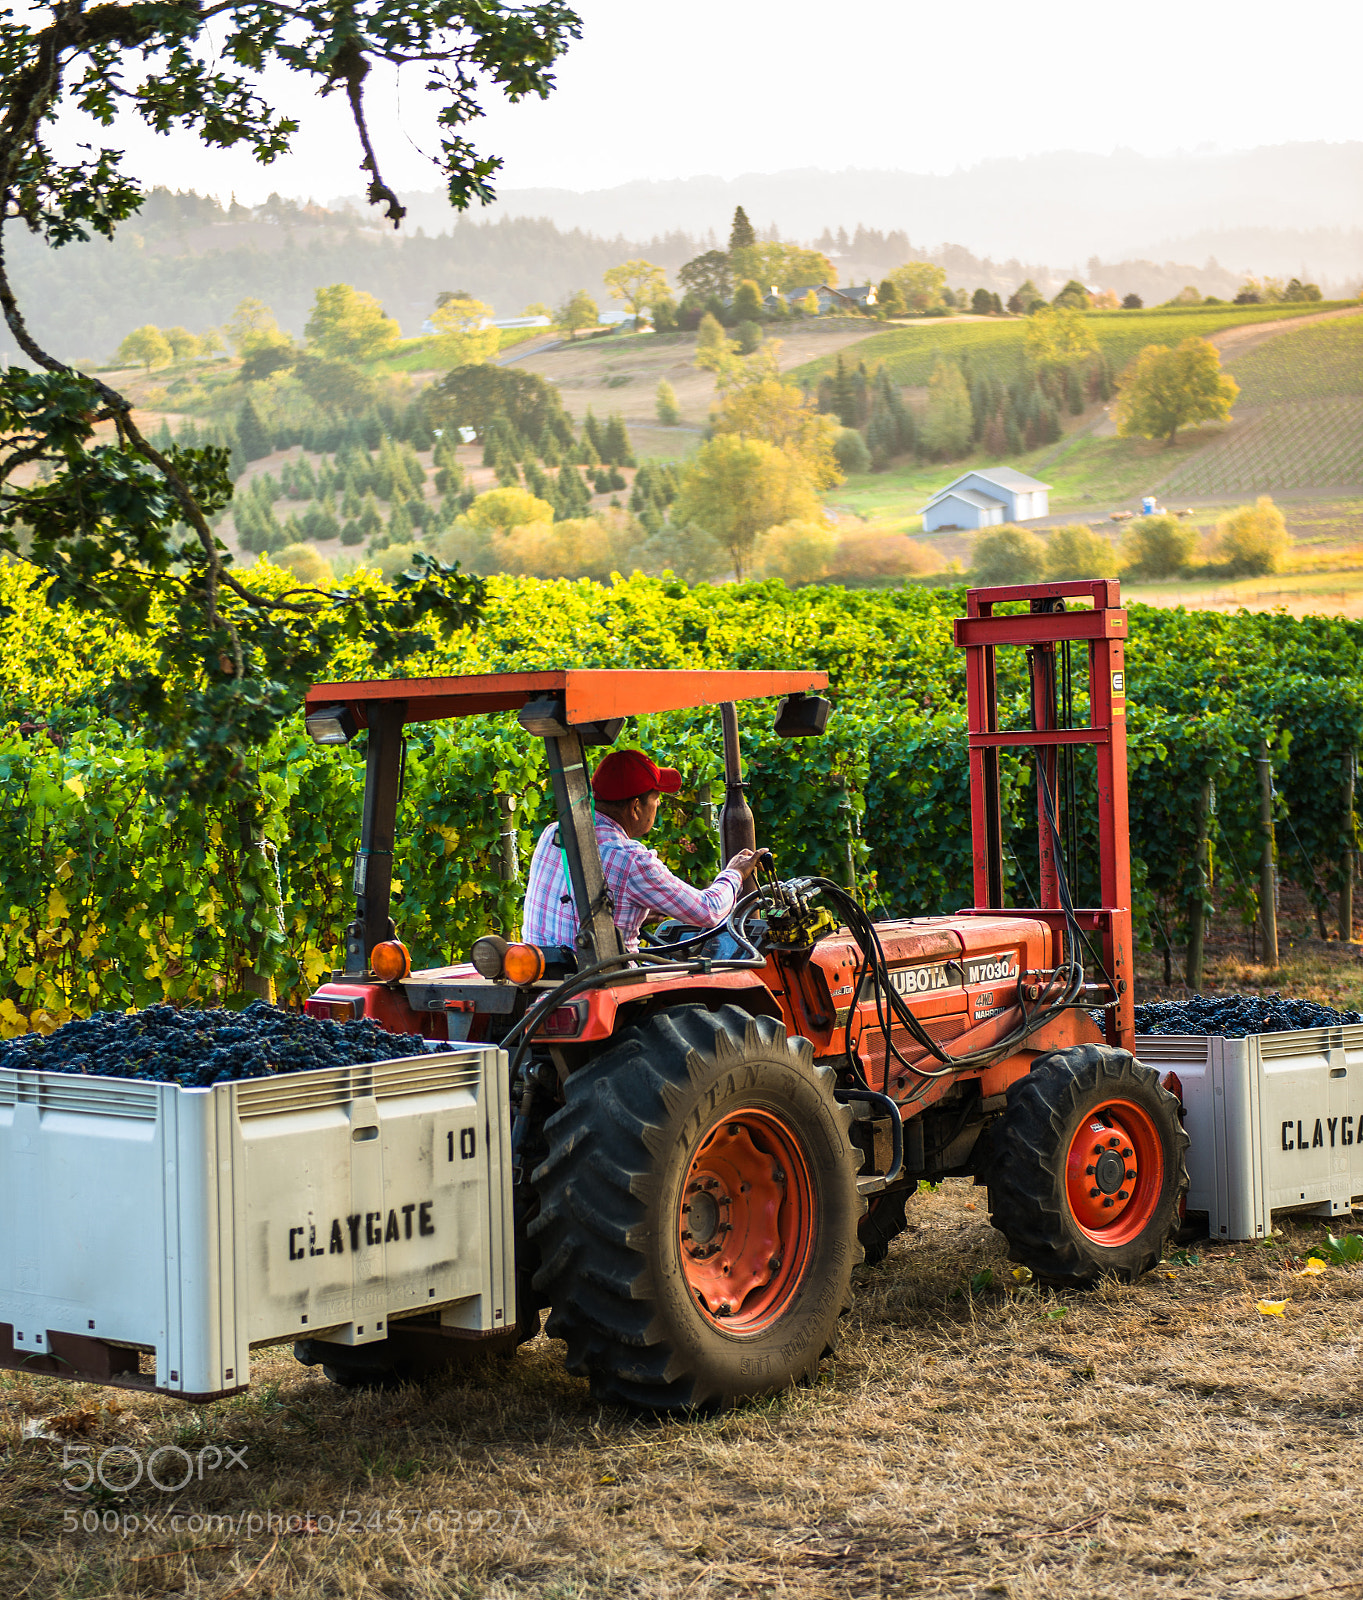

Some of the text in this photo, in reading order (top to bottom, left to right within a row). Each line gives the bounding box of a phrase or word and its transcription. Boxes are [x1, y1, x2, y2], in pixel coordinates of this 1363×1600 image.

[676, 1064, 760, 1150] TITAN
[446, 1127, 476, 1162] 10
[289, 1201, 434, 1261] CLAYGATE
[740, 1354, 772, 1376] LUG
